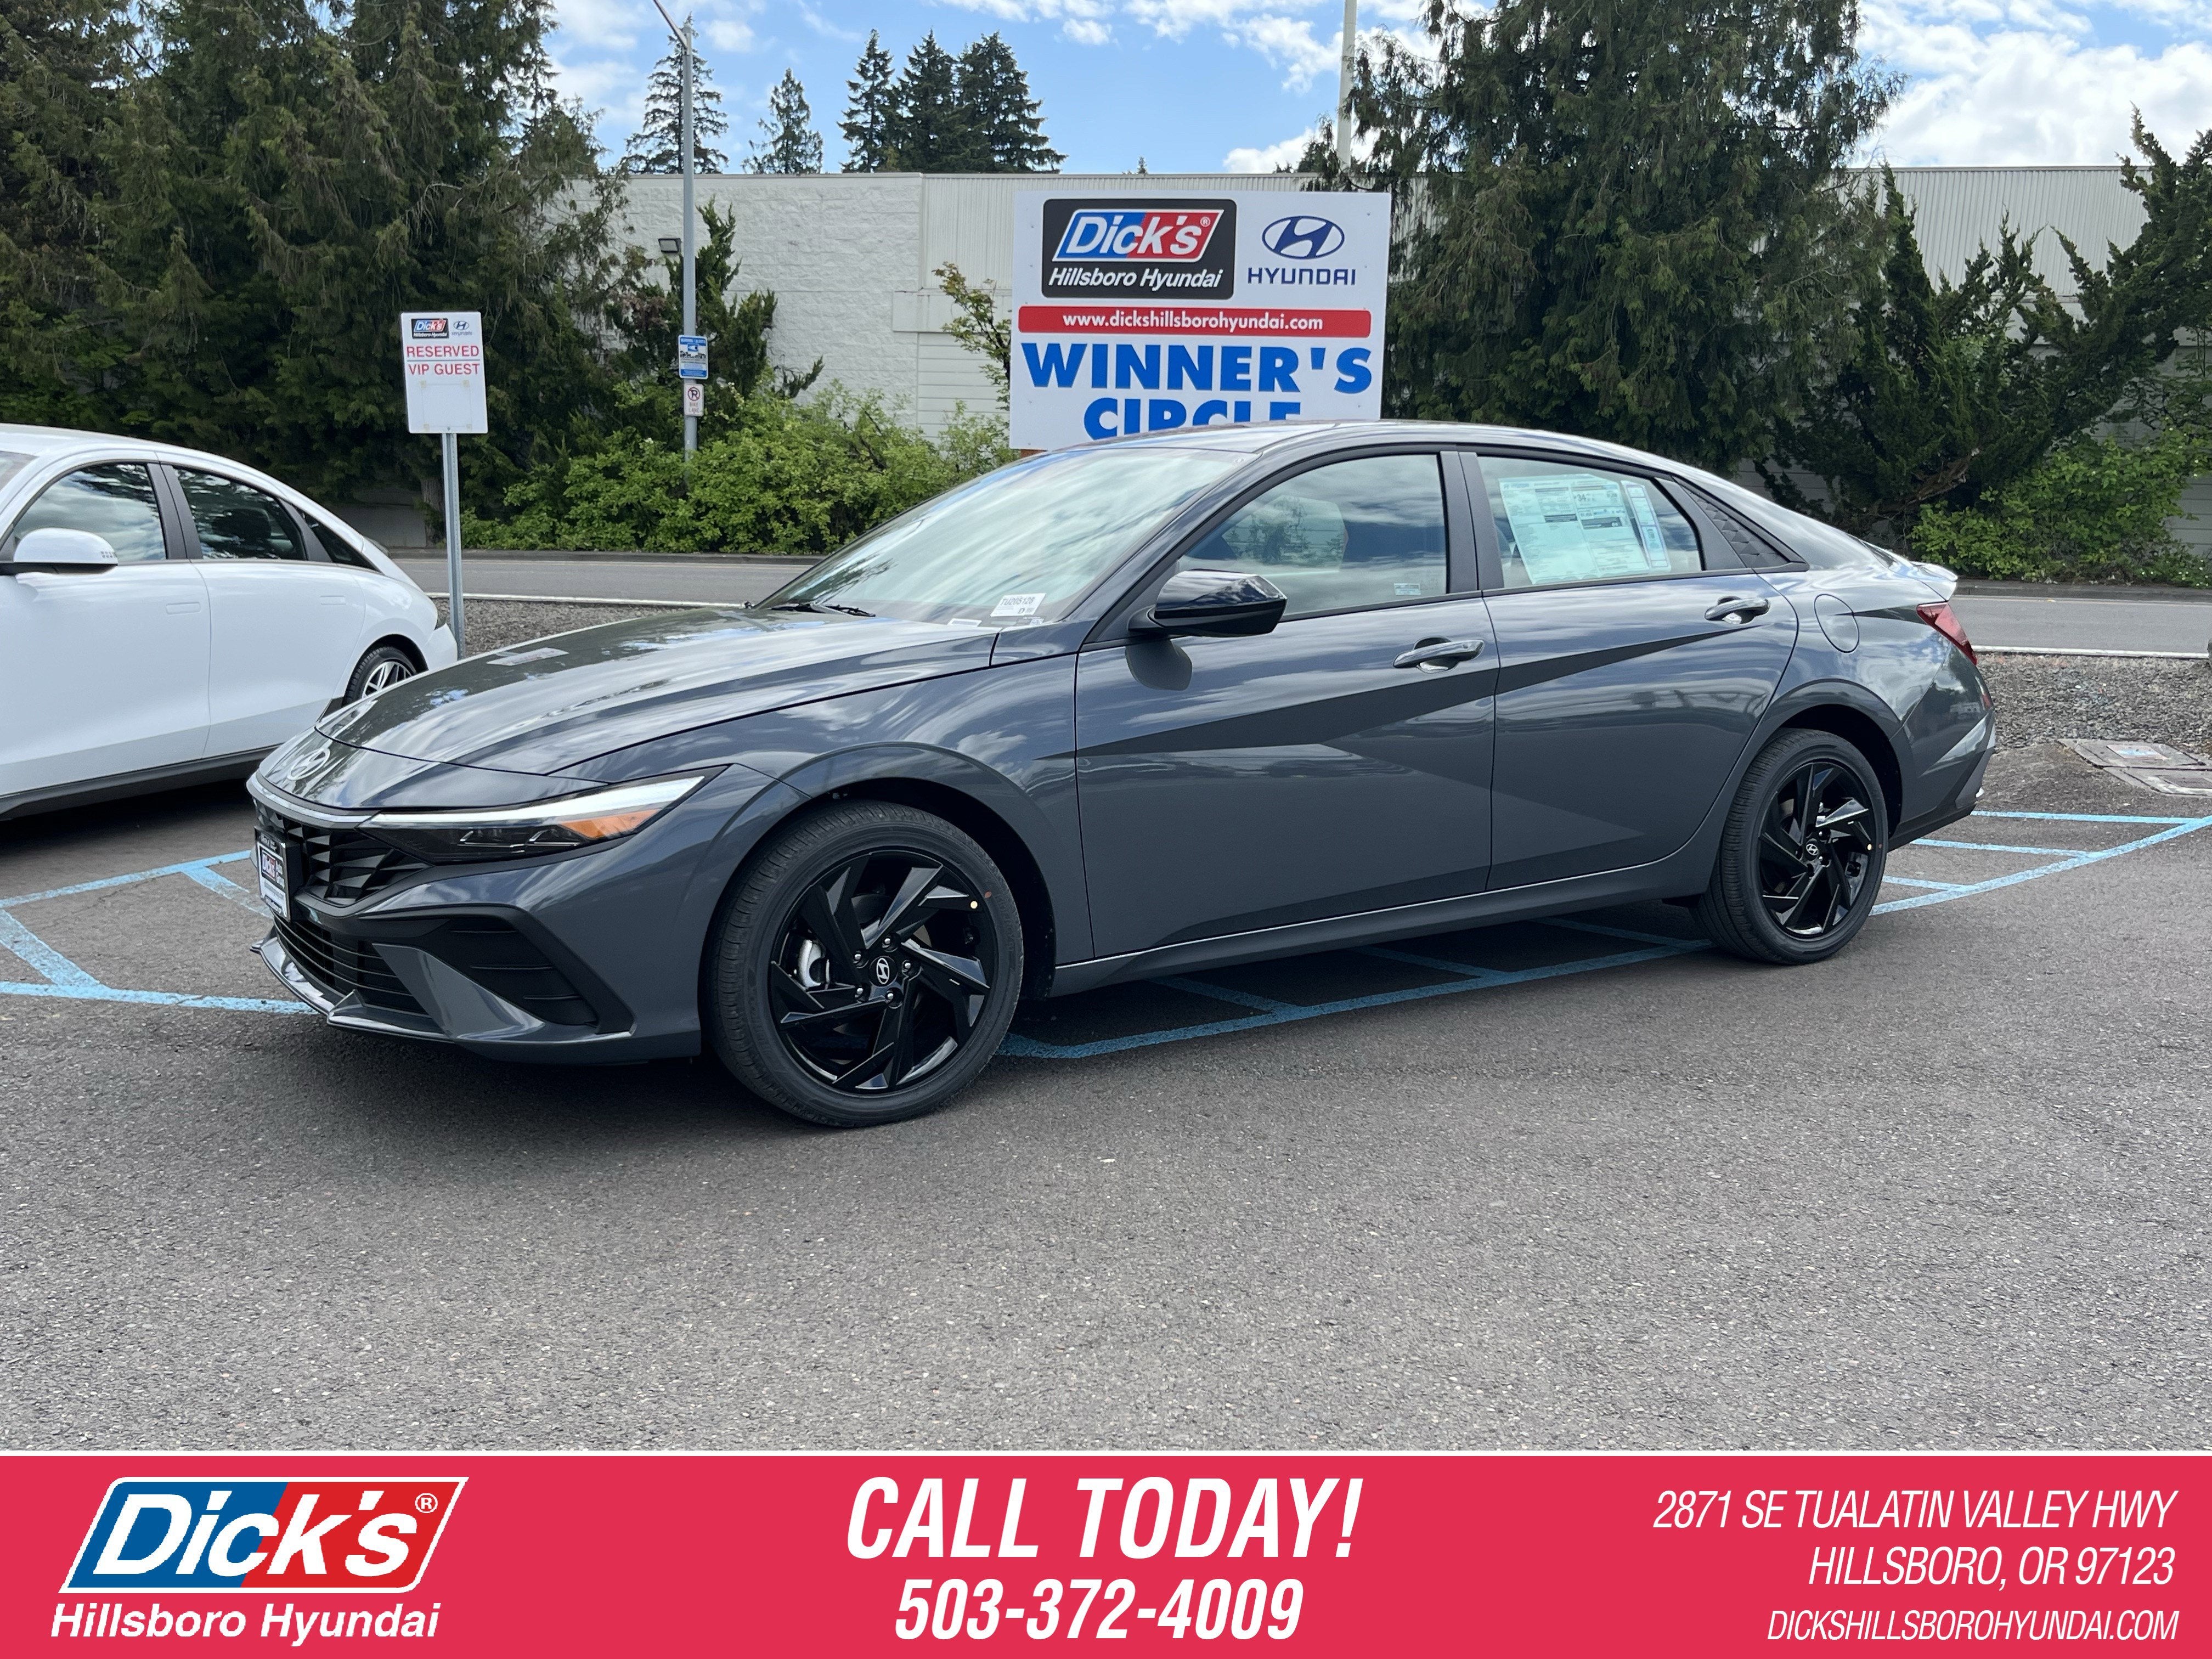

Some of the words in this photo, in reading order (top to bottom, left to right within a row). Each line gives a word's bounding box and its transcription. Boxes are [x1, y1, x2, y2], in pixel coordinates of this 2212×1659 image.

[1065, 215, 1202, 255] Dick's
[1048, 267, 1137, 287] Hillsboro
[1139, 268, 1224, 292] Hyundai
[1248, 268, 1356, 285] HYUNDAI
[1062, 309, 1323, 333] www.dickshillsborohyundai.com
[407, 346, 479, 357] RESERVED
[408, 364, 430, 375] VIP
[434, 363, 481, 375] GUEST
[1020, 342, 1372, 394] WINNER'S
